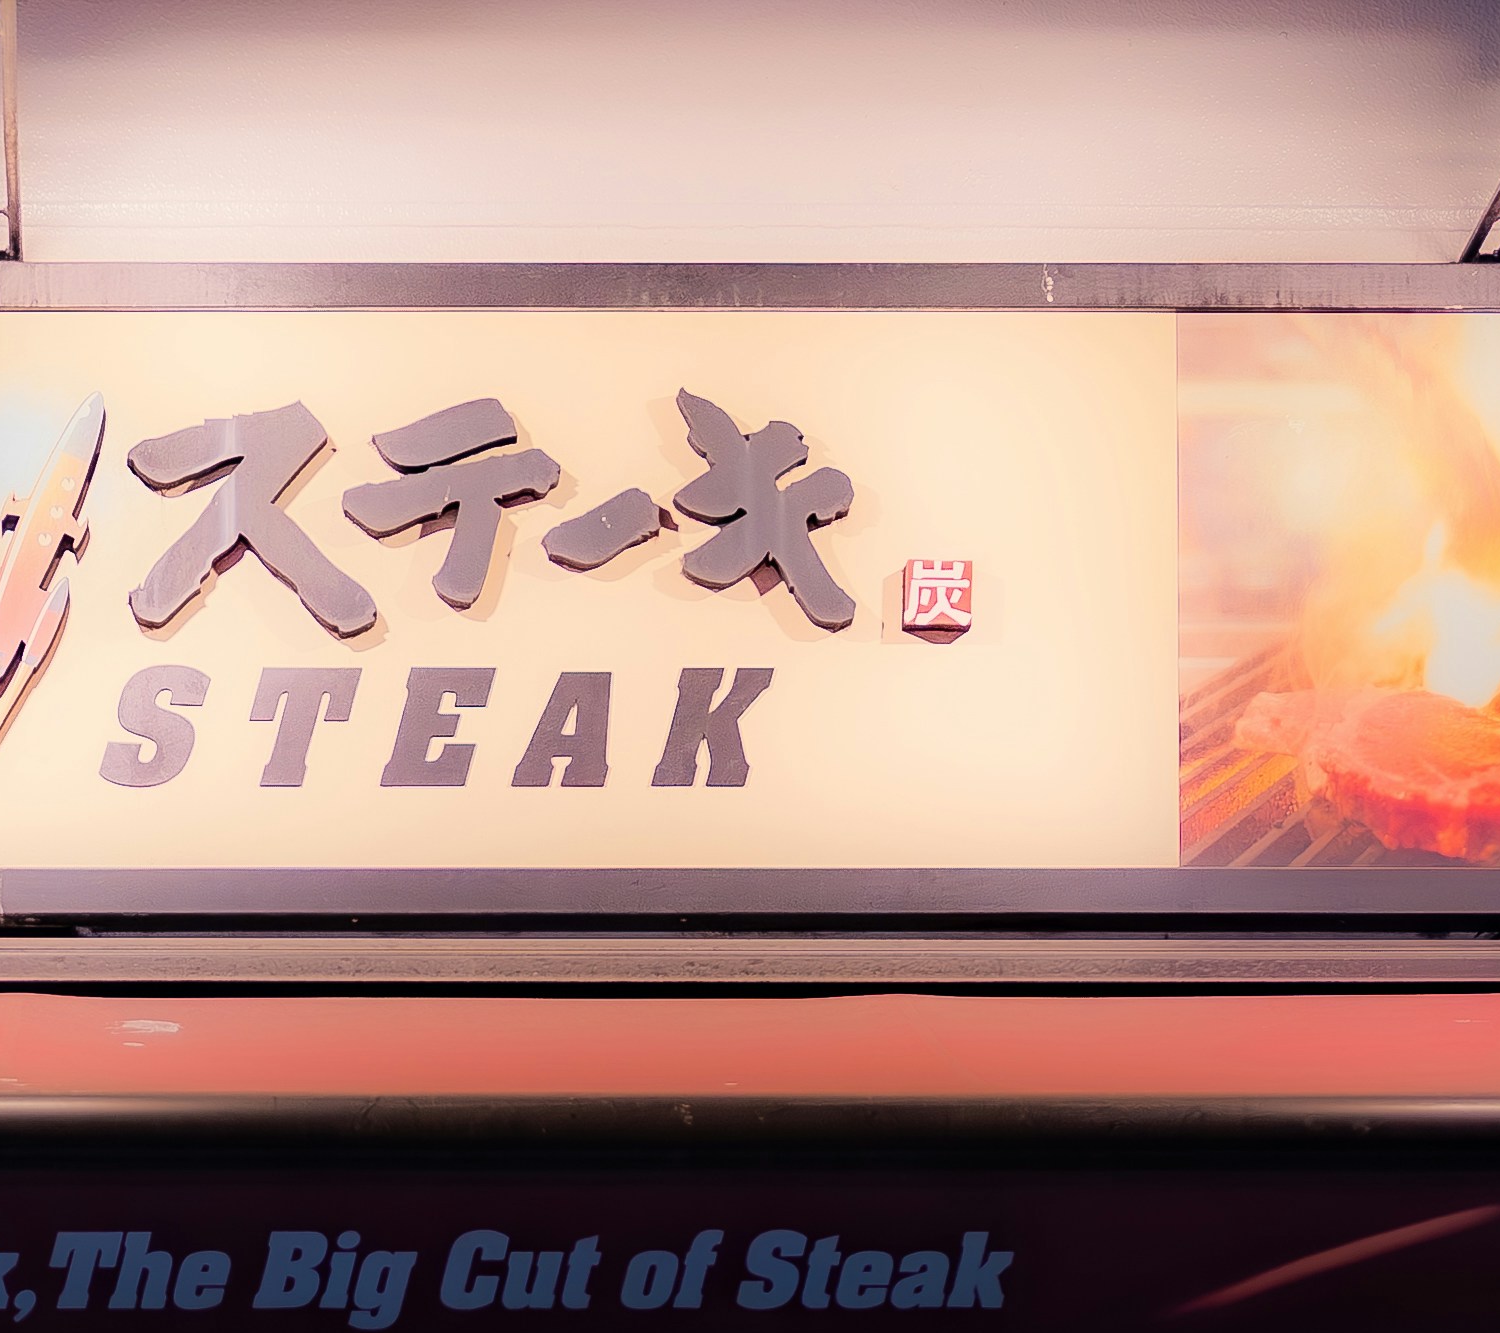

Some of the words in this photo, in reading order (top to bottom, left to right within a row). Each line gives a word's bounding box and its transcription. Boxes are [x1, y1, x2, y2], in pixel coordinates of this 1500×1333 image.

[128, 387, 857, 641] ステーキ
[99, 665, 775, 788] STEAK
[251, 1231, 417, 1329] Big
[438, 1229, 600, 1310] Cut
[619, 1229, 724, 1310] of
[735, 1229, 1013, 1310] Steak
